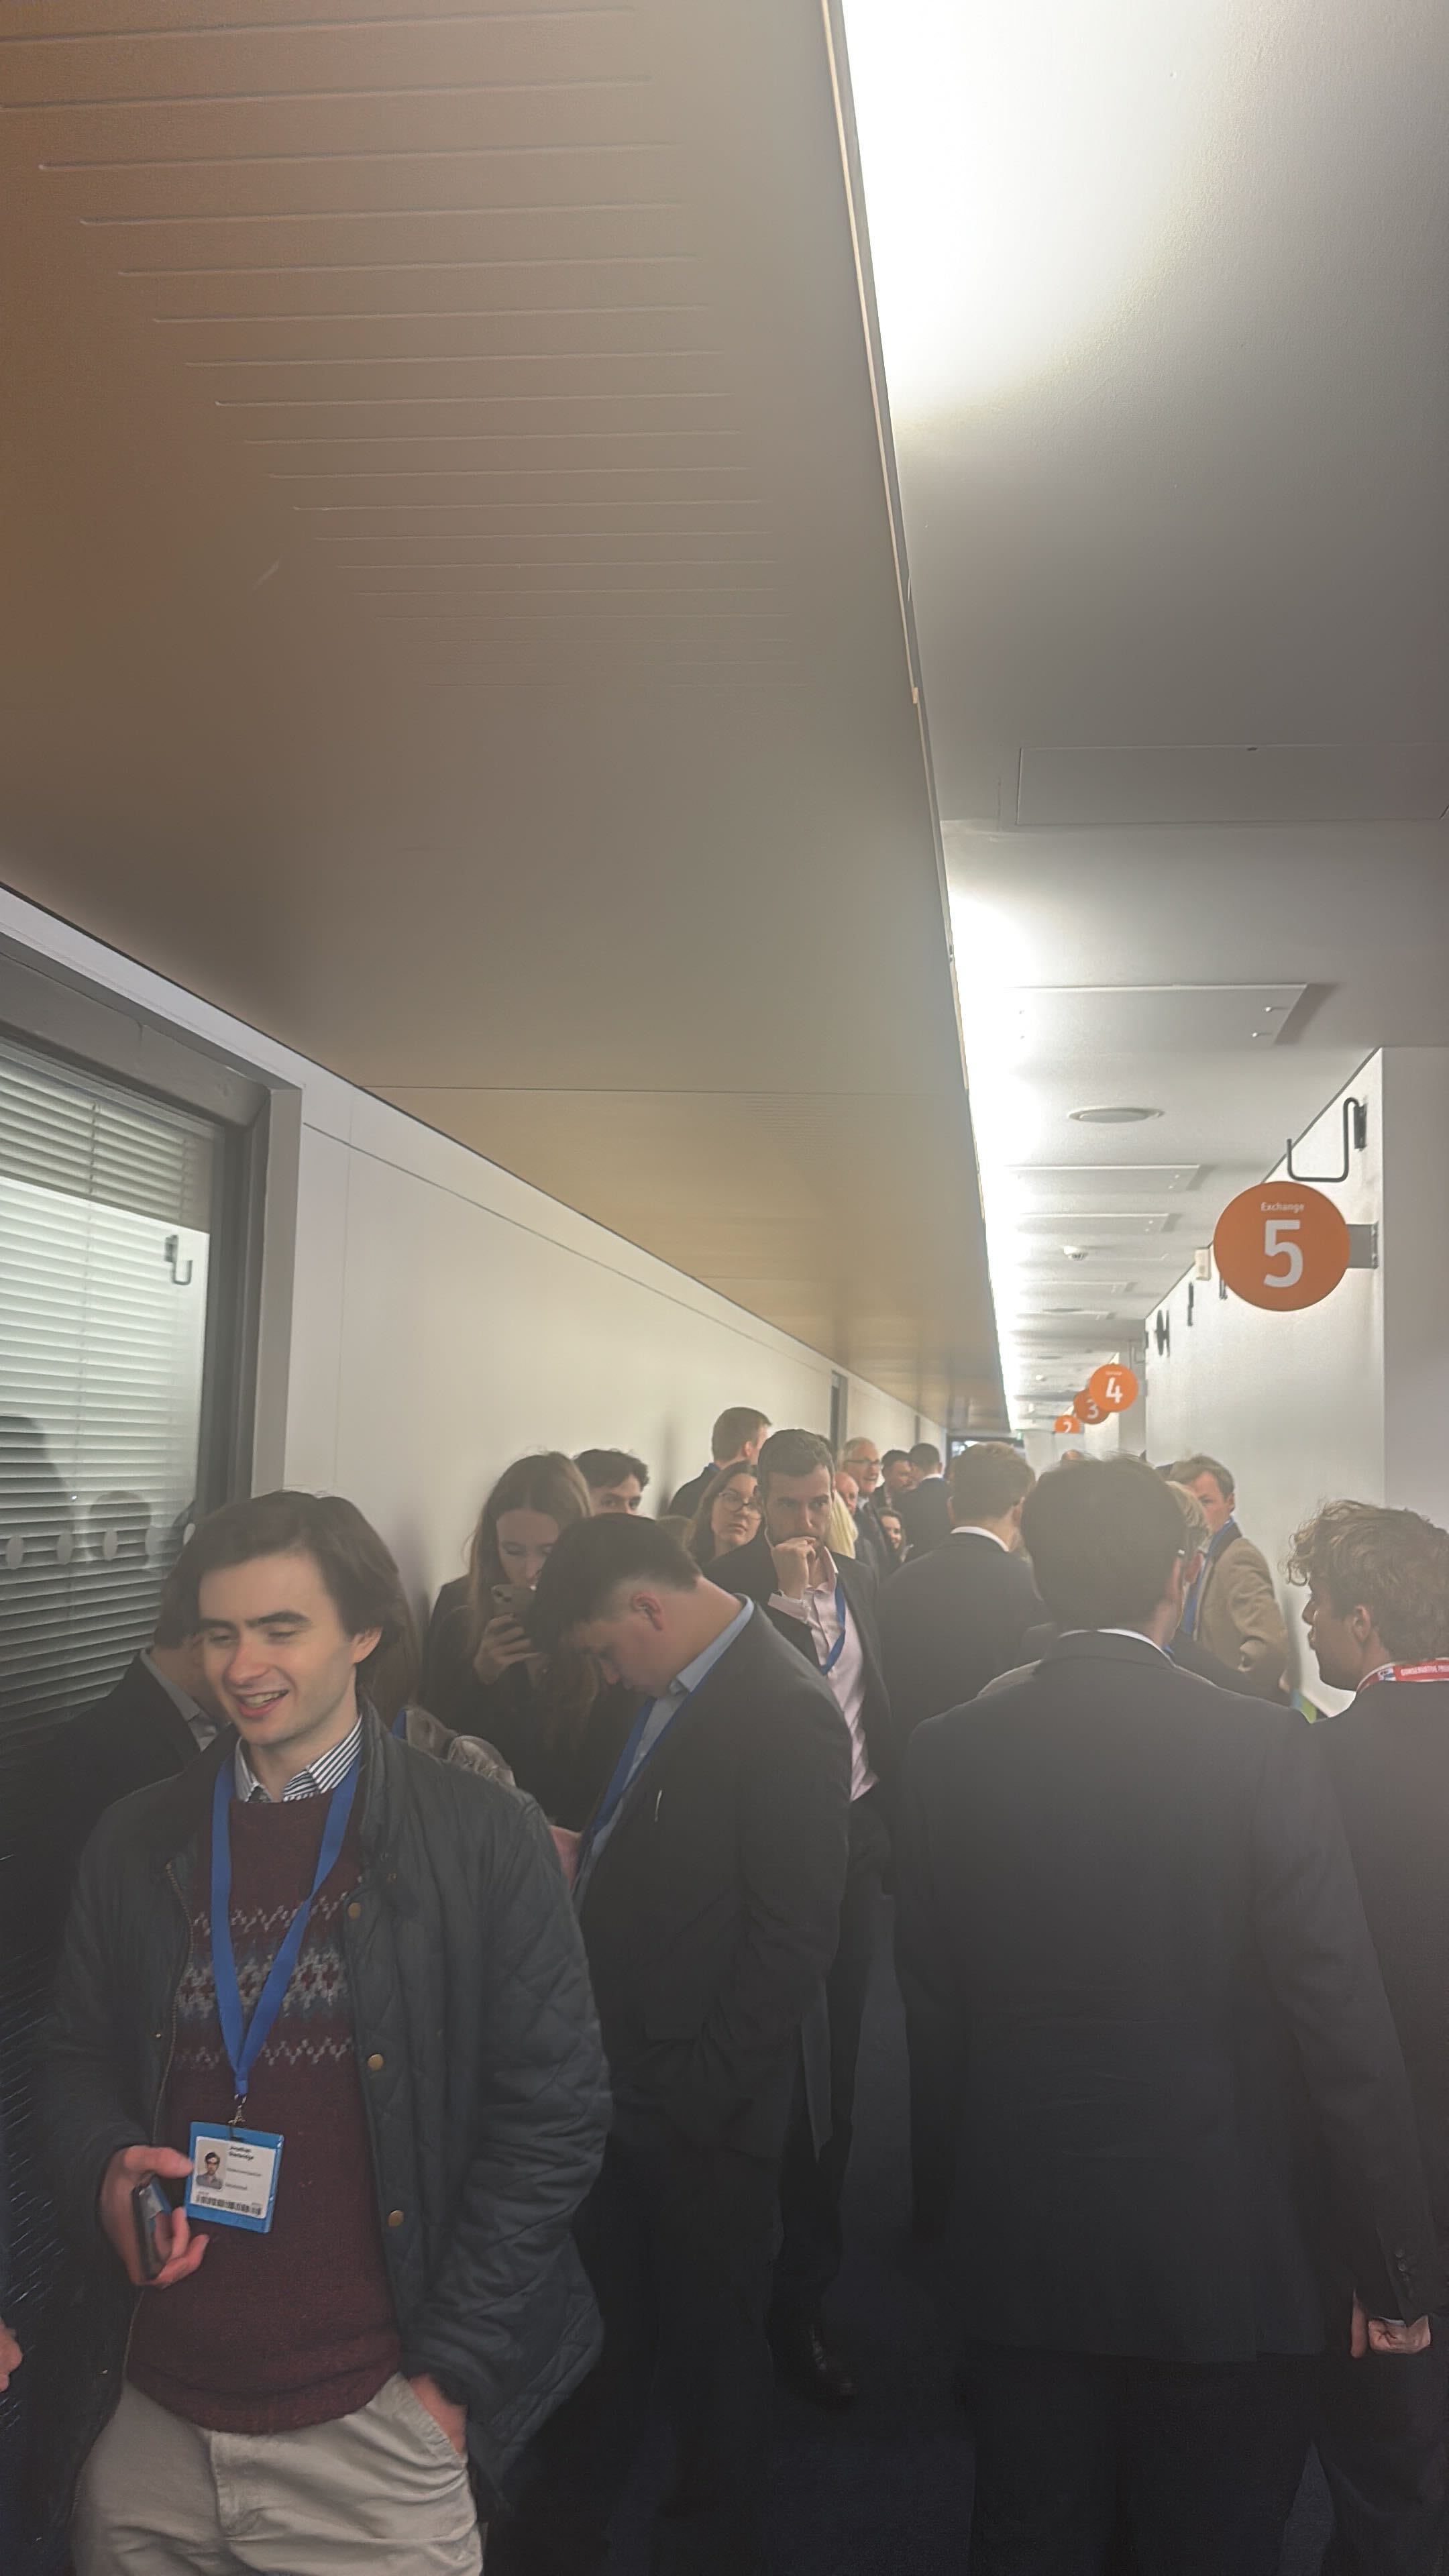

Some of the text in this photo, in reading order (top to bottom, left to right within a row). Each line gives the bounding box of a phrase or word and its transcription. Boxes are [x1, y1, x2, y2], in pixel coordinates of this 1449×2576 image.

[1260, 1201, 1304, 1214] Exchange
[1263, 1219, 1303, 1287] 5
[1105, 1377, 1123, 1403] 4
[1087, 1399, 1099, 1419] 3
